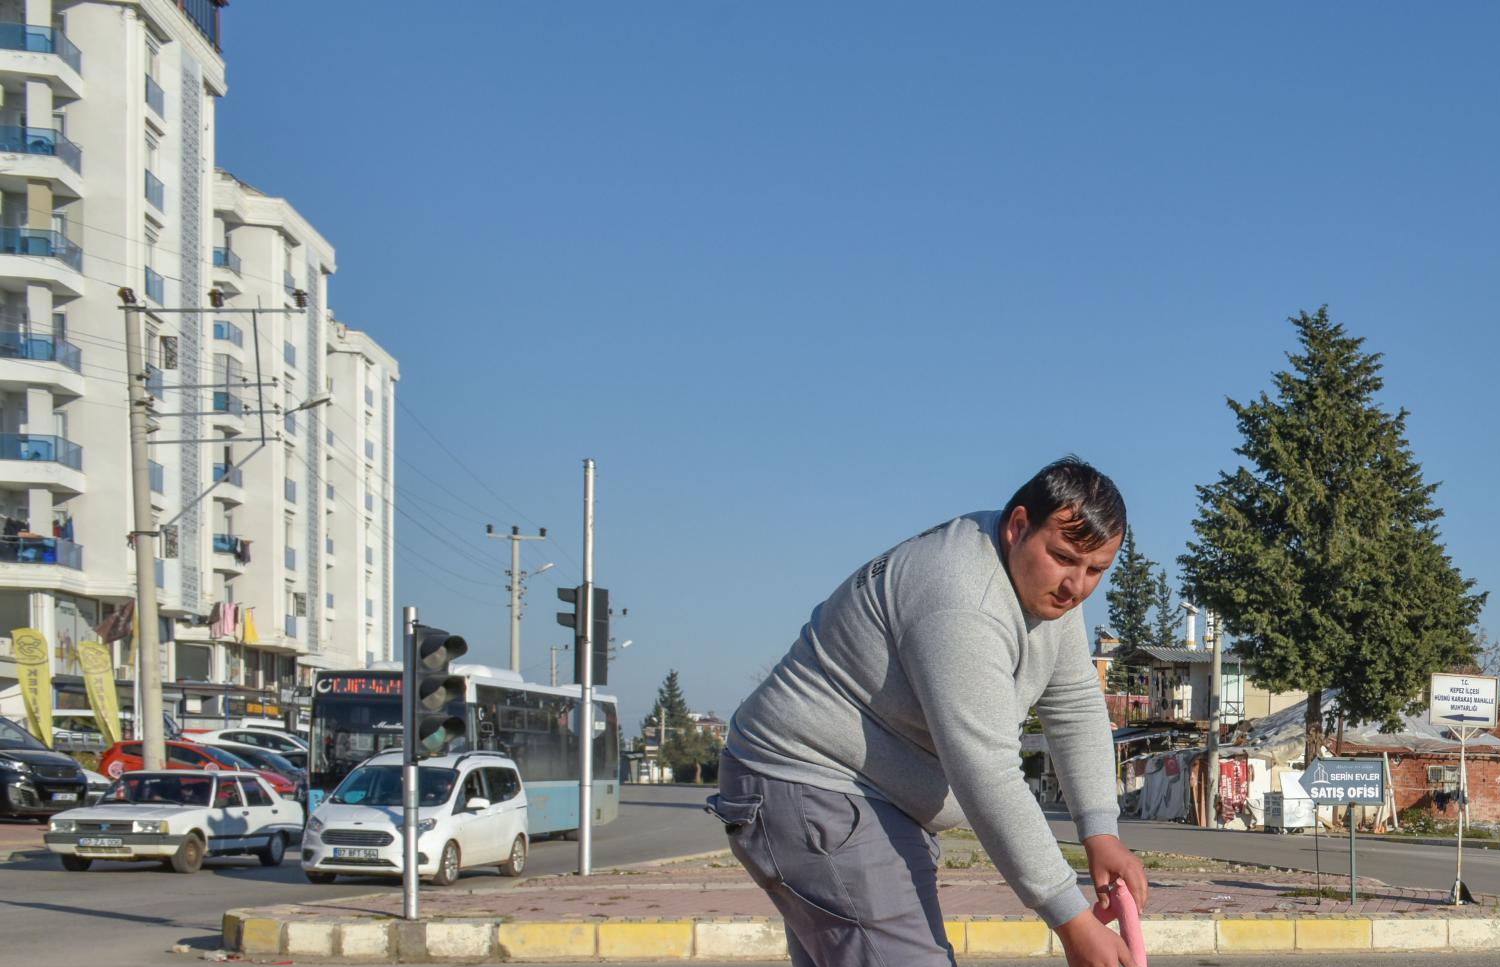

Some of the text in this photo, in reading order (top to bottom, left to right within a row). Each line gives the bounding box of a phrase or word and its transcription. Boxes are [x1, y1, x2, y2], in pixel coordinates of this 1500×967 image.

[1330, 772, 1380, 781] SERİN EVLER
[1310, 784, 1379, 801] SATIŞ OFİSİ
